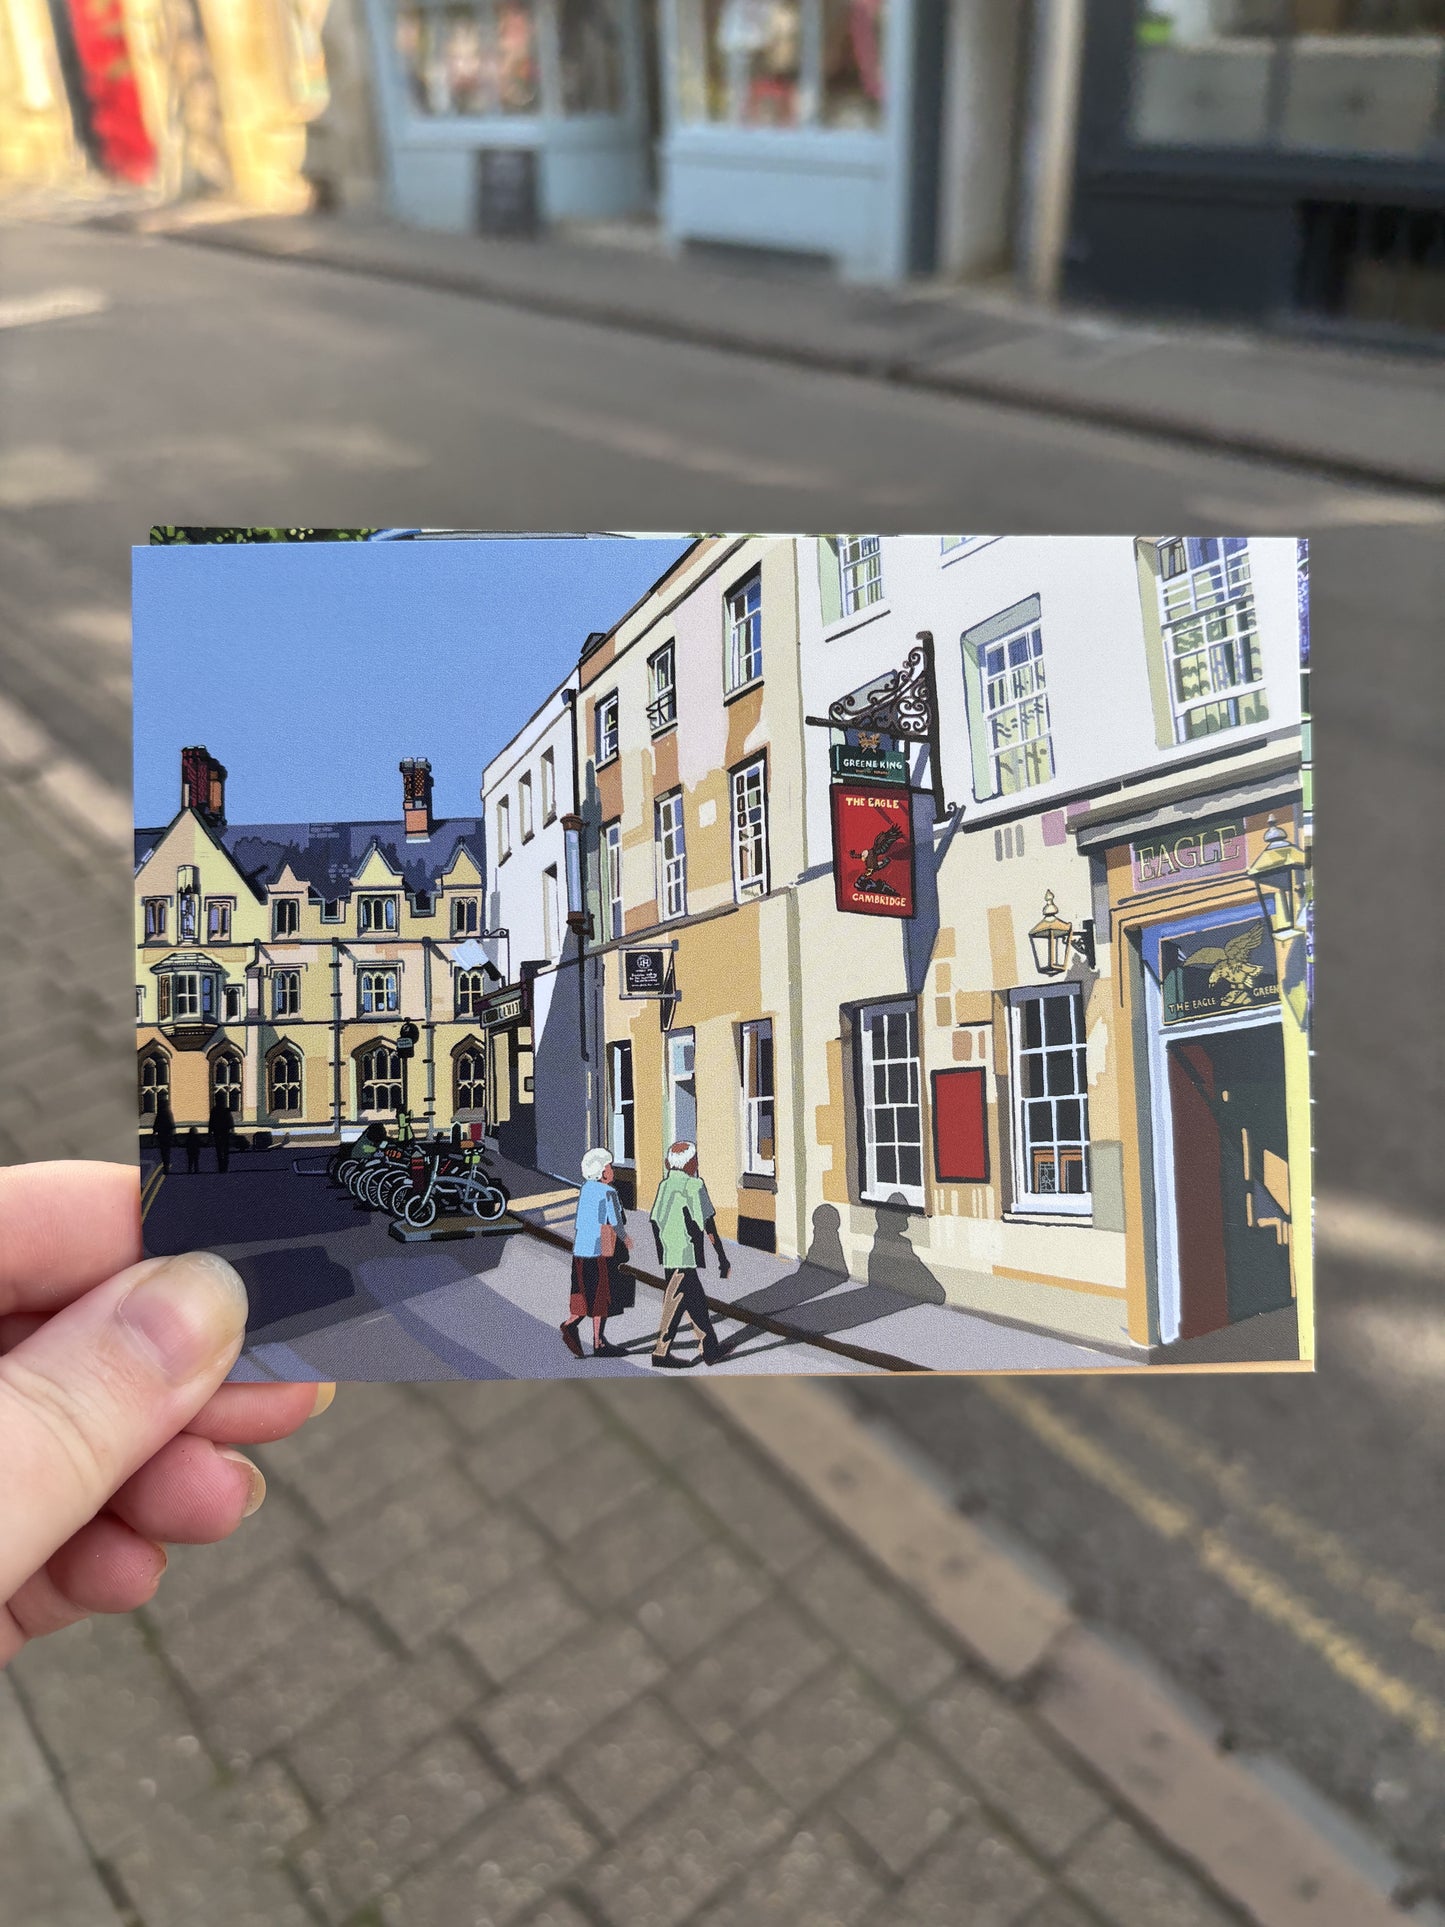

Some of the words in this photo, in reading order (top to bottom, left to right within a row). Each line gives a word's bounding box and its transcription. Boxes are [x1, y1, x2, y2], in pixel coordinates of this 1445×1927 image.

[843, 759, 877, 768] GREENE
[880, 760, 903, 770] KING
[845, 797, 865, 807] THE
[868, 797, 899, 809] EAGLE
[1138, 825, 1241, 882] EAGLE
[852, 893, 907, 907] CAMBRIDGE
[1168, 1003, 1190, 1014] THE
[1192, 997, 1216, 1009] EAGLE
